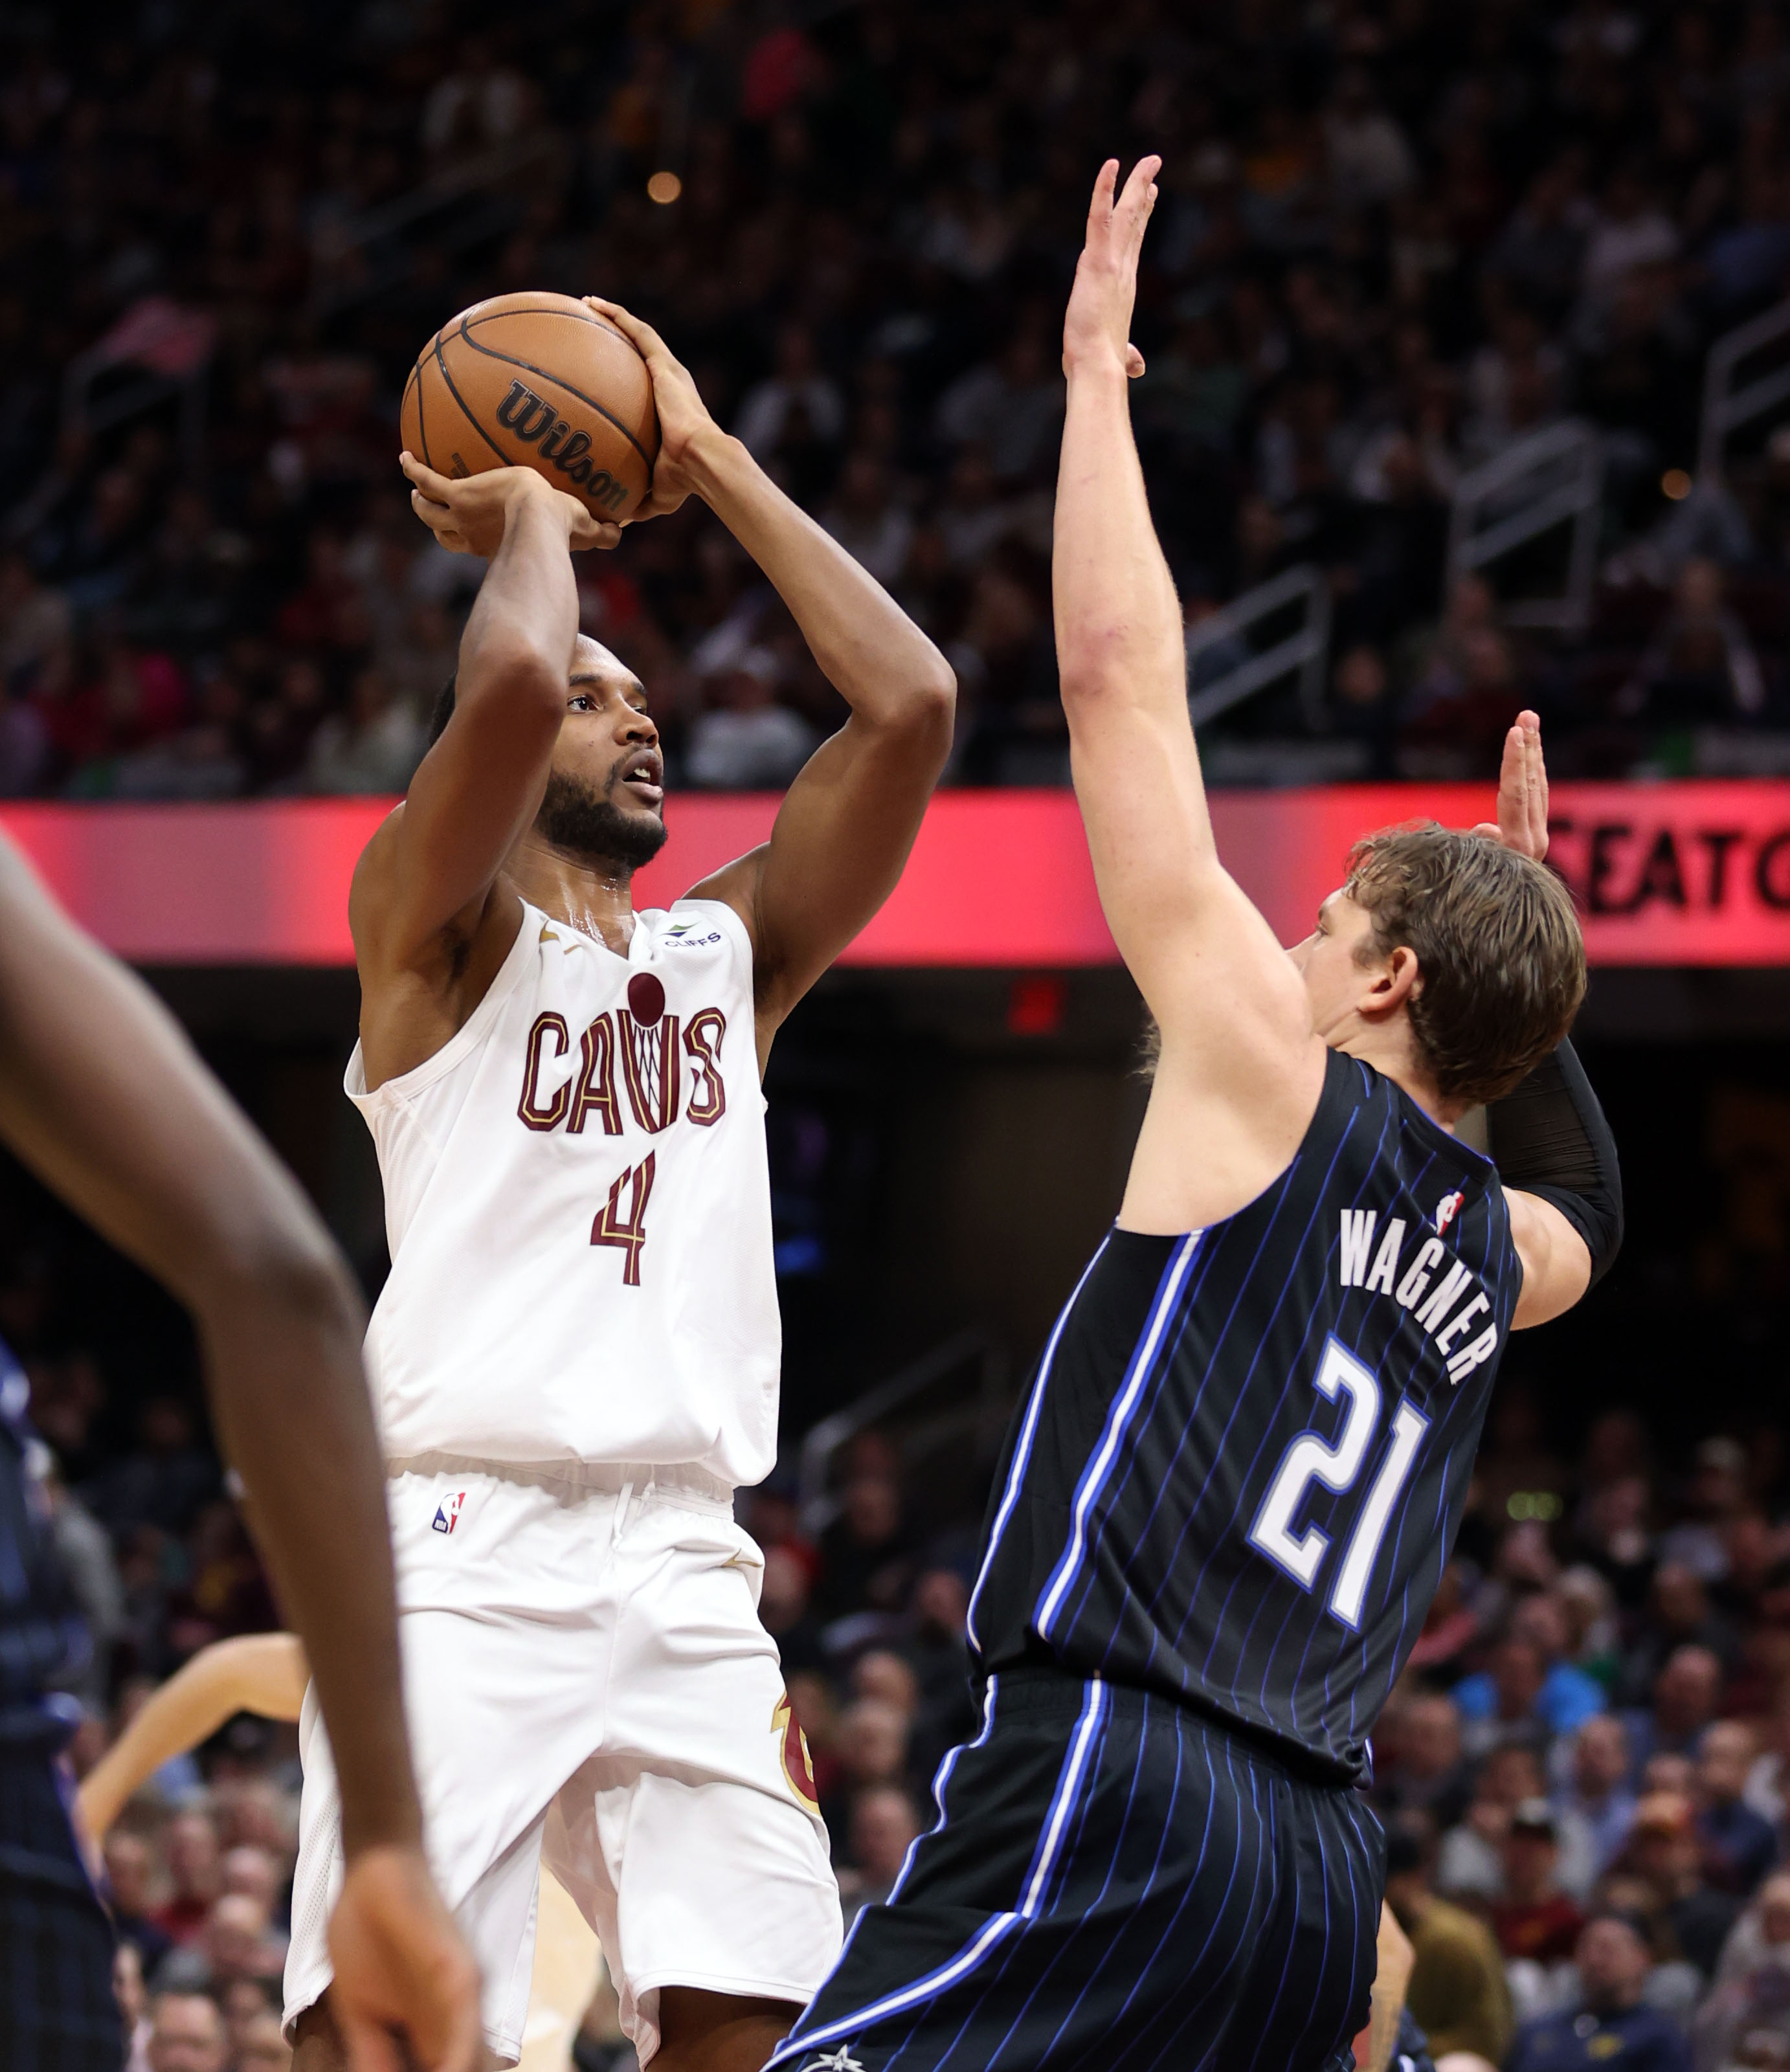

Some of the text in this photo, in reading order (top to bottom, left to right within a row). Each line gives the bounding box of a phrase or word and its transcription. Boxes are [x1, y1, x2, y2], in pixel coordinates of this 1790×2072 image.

[497, 378, 629, 511] Wilson
[664, 932, 721, 947] CLIFFS
[517, 1007, 726, 1135] CAVS
[590, 1149, 655, 1286] 4
[1339, 1209, 1498, 1386] WAGNER
[434, 1519, 447, 1531] NBA
[1249, 1332, 1431, 1632] 21
